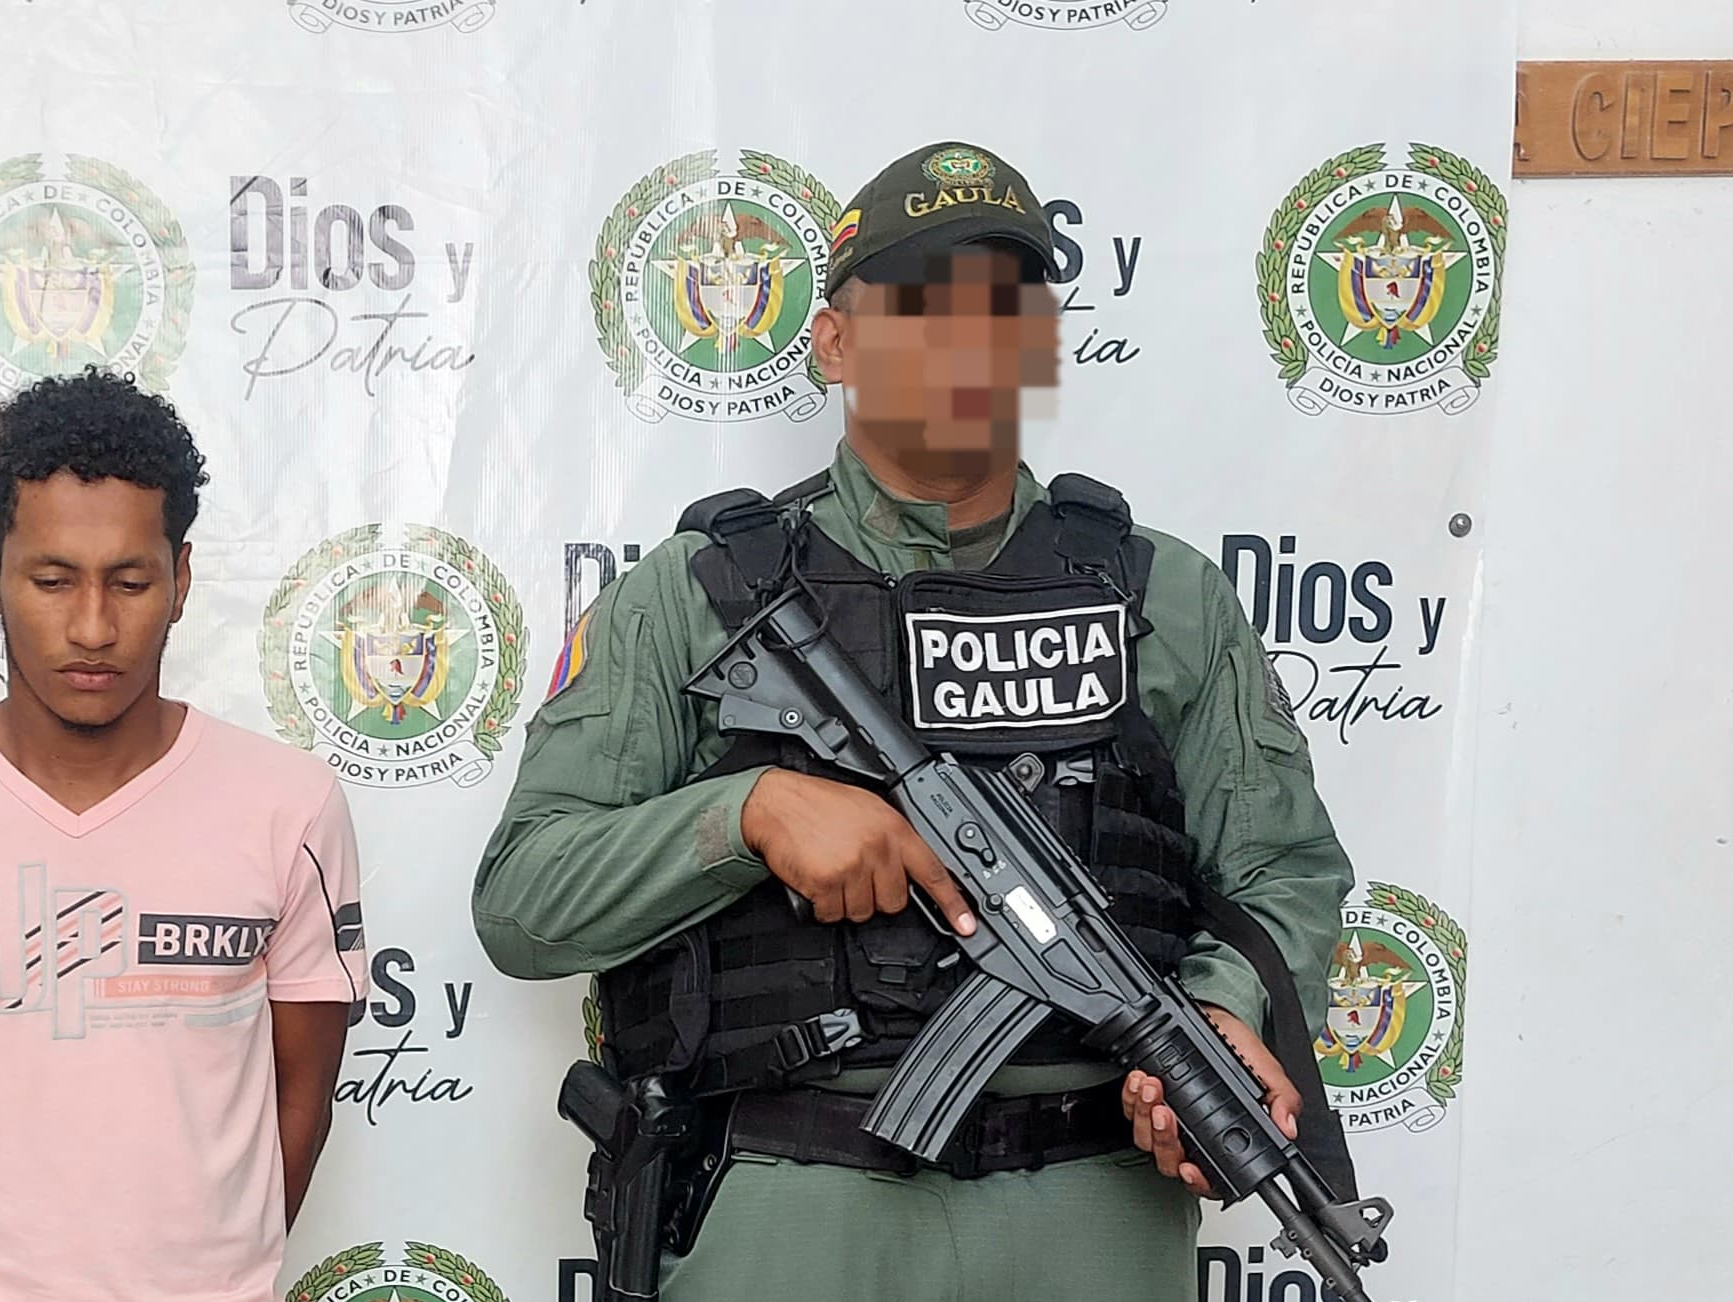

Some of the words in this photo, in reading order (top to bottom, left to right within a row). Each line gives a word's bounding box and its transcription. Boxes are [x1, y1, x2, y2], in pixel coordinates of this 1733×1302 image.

[44, 186, 73, 199] DE
[904, 184, 1027, 218] GAULA
[229, 175, 416, 291] Dios
[444, 241, 475, 304] y
[717, 182, 746, 196] DE
[769, 194, 827, 300] COLOMBIA
[1386, 175, 1413, 188] DE
[1435, 187, 1491, 293] COLOMBIA
[1113, 237, 1142, 297] y
[230, 293, 476, 400] Patria
[729, 328, 811, 390] NACIONA
[1387, 320, 1478, 382] NACIONAL
[727, 386, 795, 416] PATRIA
[1385, 379, 1451, 408] PATRIA
[382, 555, 411, 568] DE
[1221, 534, 1393, 645] Dios
[1419, 594, 1446, 655] y
[921, 620, 1117, 670] POLICIA
[933, 674, 1110, 719] GAULA
[396, 695, 486, 756] NACIONAL
[395, 753, 462, 782] PATRIA
[117, 979, 150, 994] STAY
[154, 978, 212, 993] STRONG
[1346, 912, 1371, 925] DE
[1393, 922, 1452, 1020] COLOMBIA
[444, 982, 473, 1039] y
[334, 1029, 474, 1127] atria
[1351, 1045, 1440, 1102] NACIONAL
[1349, 1099, 1415, 1126] PATRIA
[384, 1270, 412, 1282] DE
